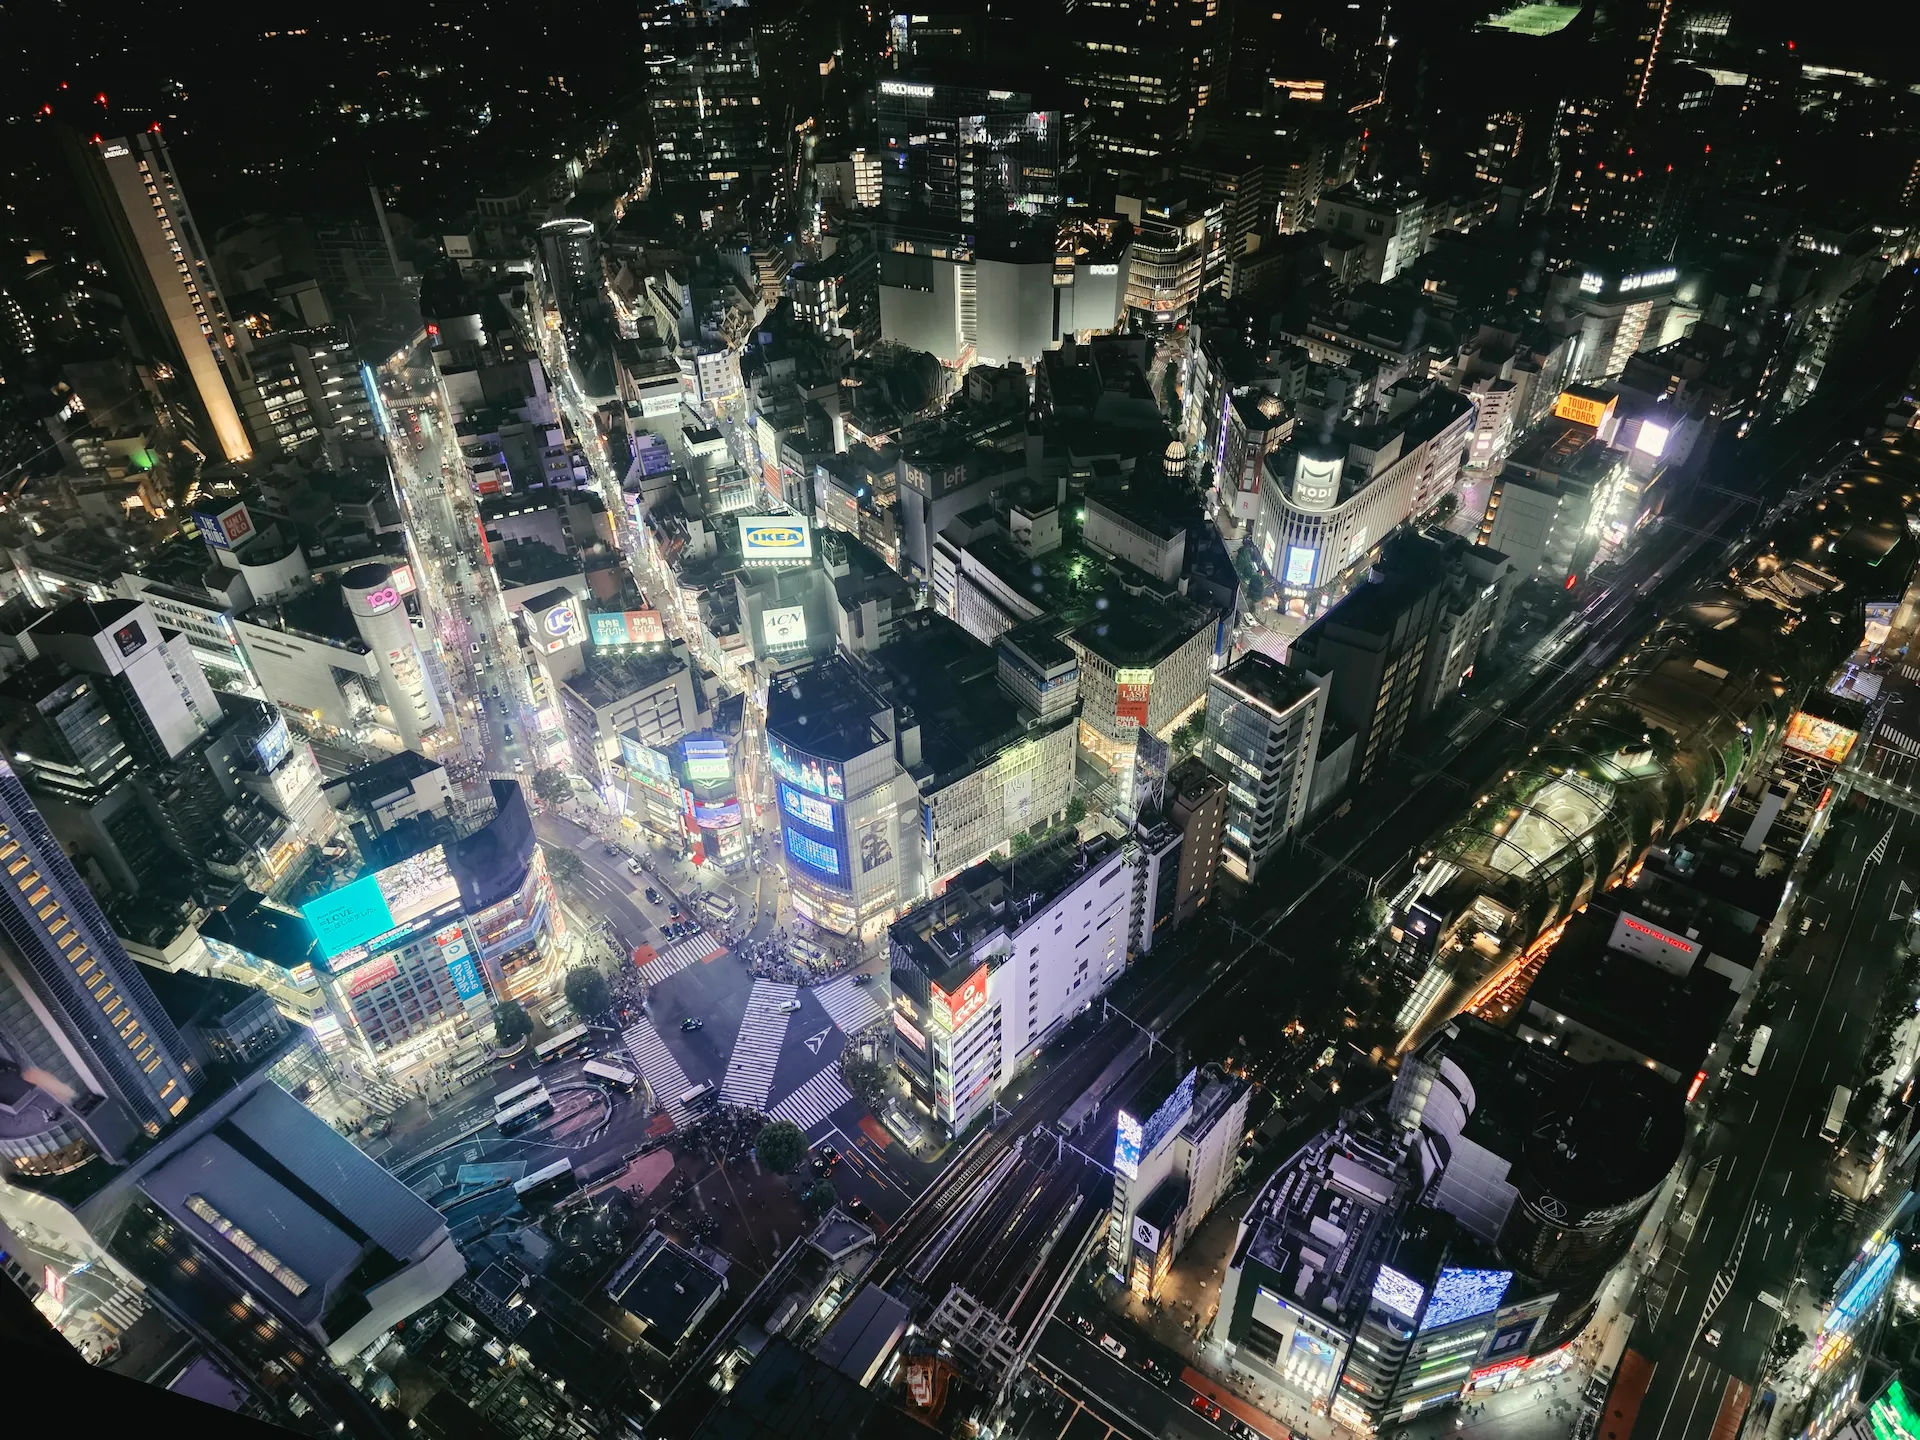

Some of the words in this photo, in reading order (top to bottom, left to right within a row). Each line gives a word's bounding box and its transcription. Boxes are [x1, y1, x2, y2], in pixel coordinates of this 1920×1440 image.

[881, 82, 906, 95] PARCO
[908, 85, 934, 97] HULIC
[104, 149, 129, 159] INDIGO
[1090, 264, 1118, 276] PARCO
[1569, 396, 1594, 412] TOWER
[1562, 406, 1597, 424] RECORDS
[1297, 483, 1333, 498] MODI
[200, 516, 217, 531] THE
[226, 513, 243, 529] UNI
[201, 528, 227, 545] PRIME
[230, 522, 248, 537] QLO
[752, 532, 800, 541] IKEA
[366, 587, 398, 608] 109
[766, 612, 802, 627] ACN
[1122, 690, 1148, 699] LAST
[1115, 715, 1138, 723] FINAL
[1624, 918, 1651, 935] TOKYU
[1665, 937, 1692, 953] HOTEL
